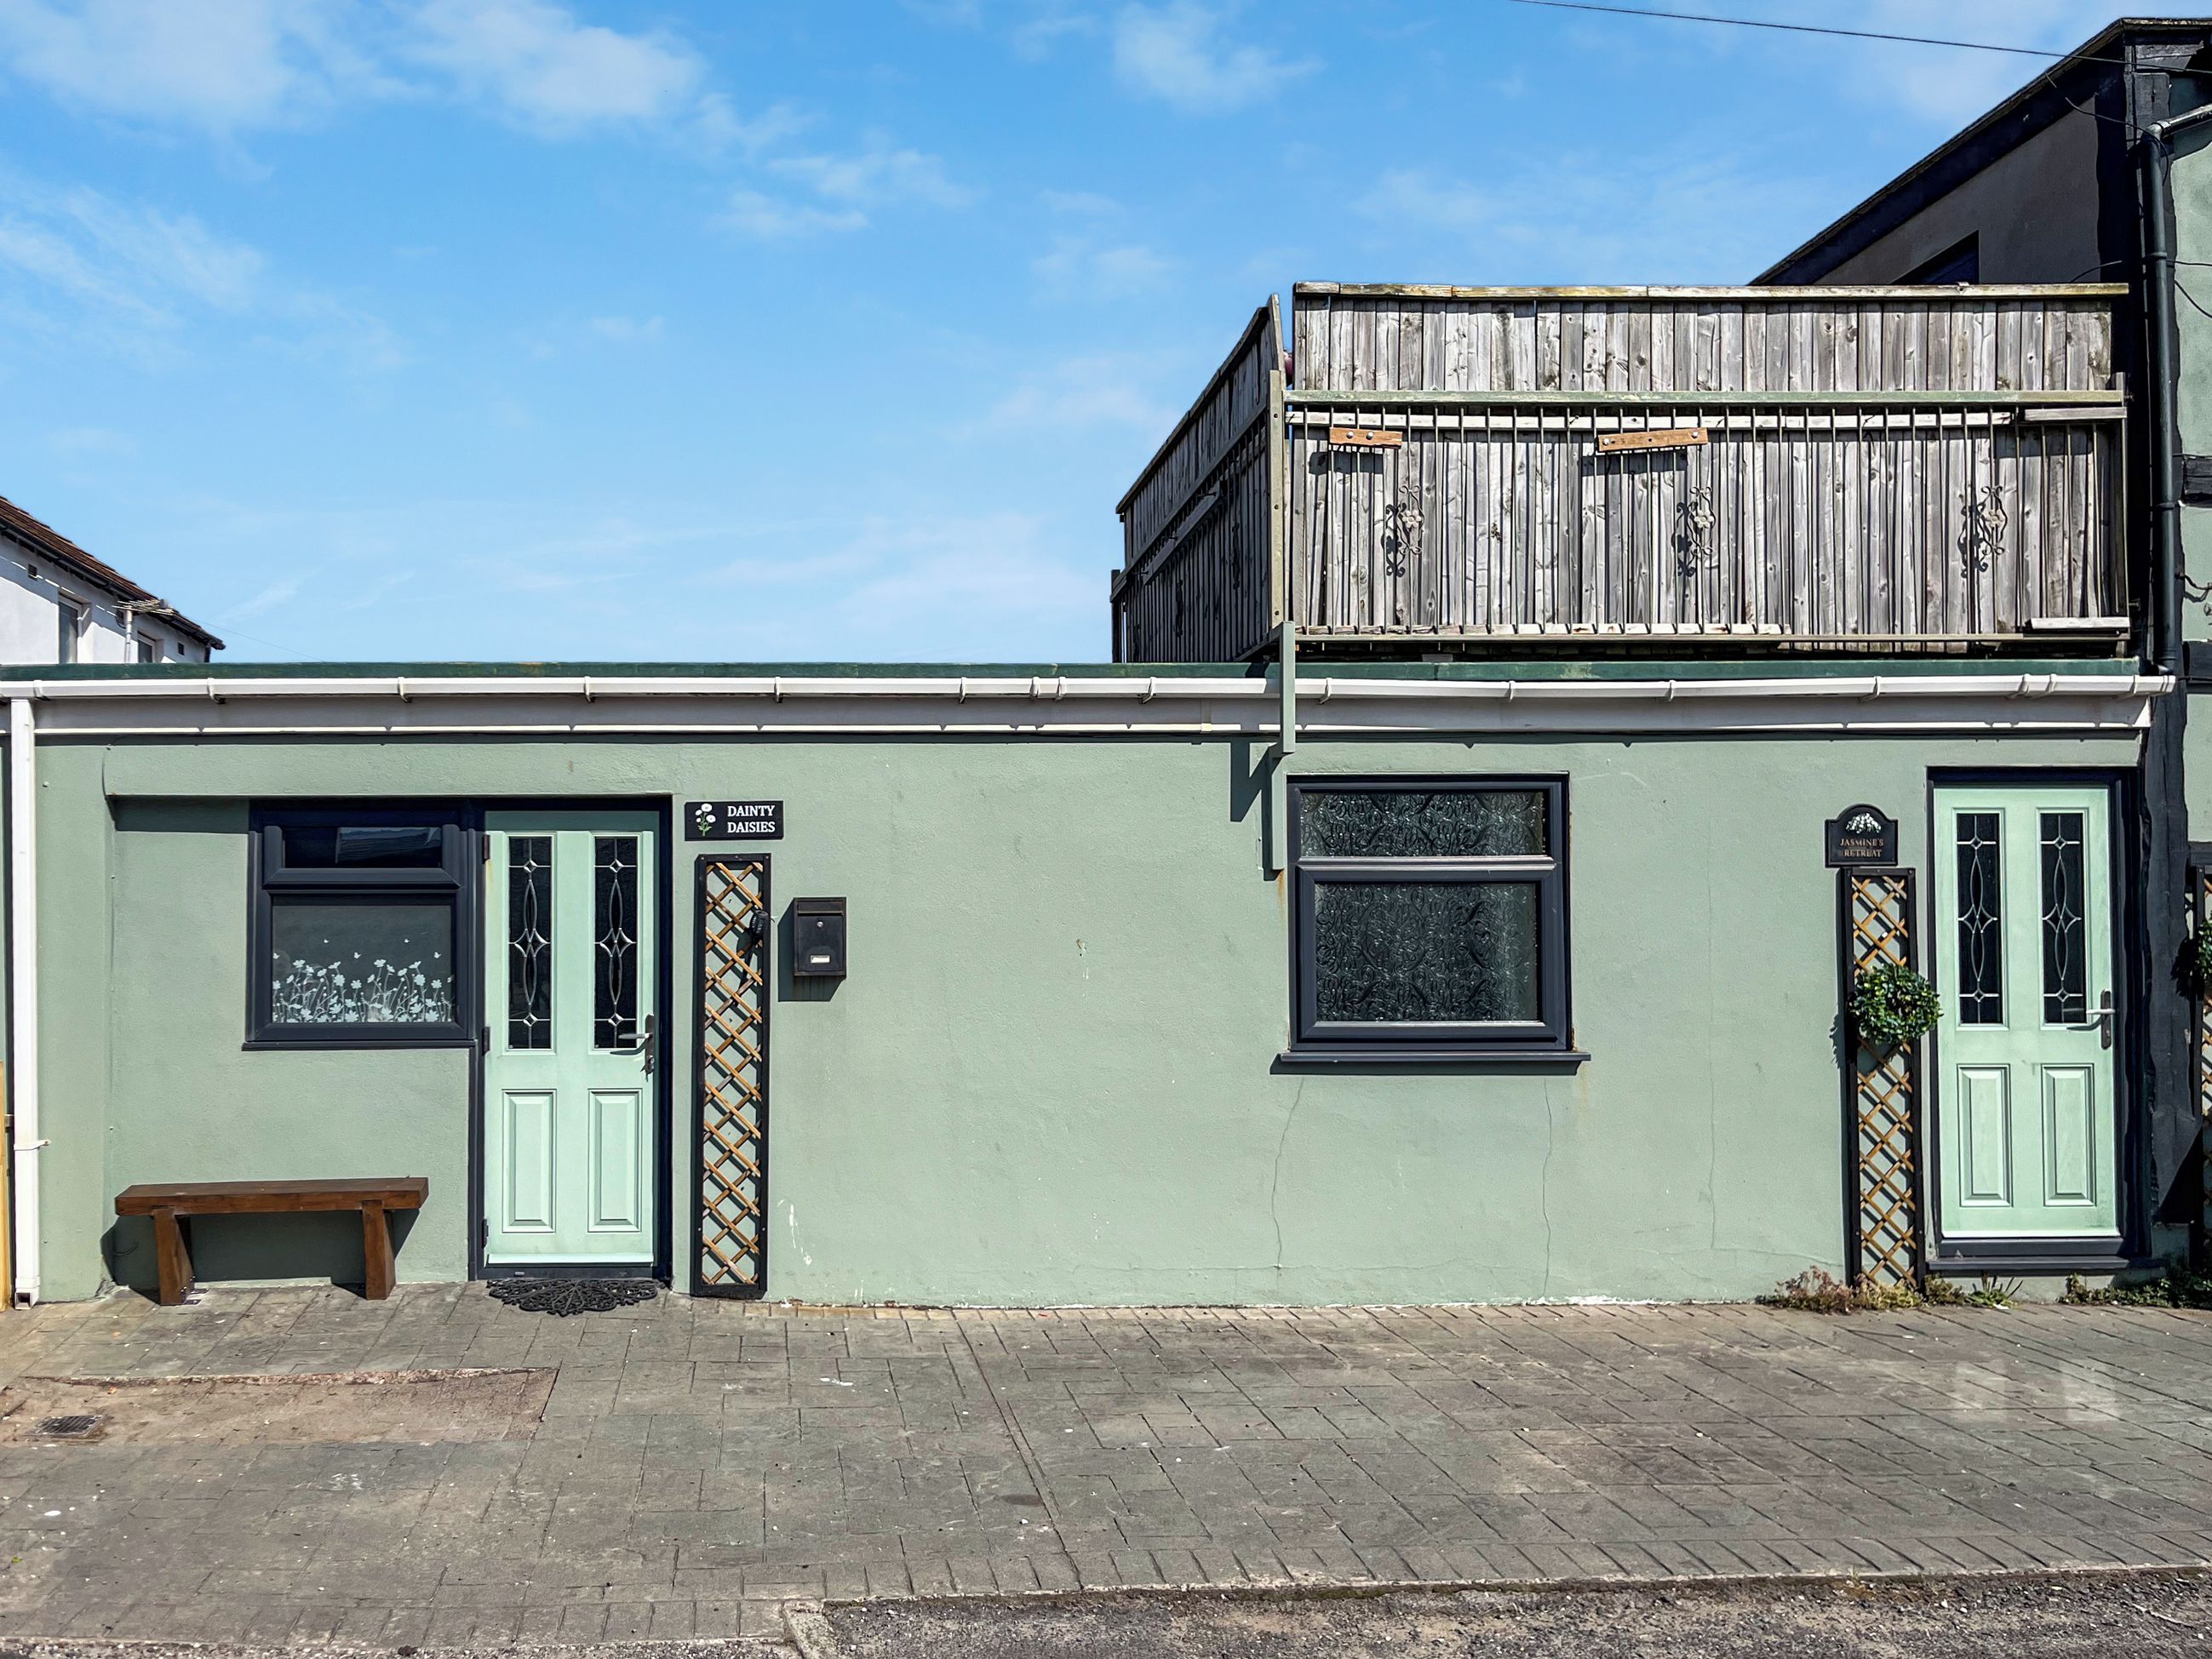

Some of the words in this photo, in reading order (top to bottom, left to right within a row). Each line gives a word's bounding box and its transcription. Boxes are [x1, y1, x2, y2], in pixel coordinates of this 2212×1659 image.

[727, 804, 776, 817] DAINTY
[727, 821, 776, 833] DAISIES
[1840, 838, 1884, 847] JASMINE'S
[1844, 849, 1882, 857] RETREAT
